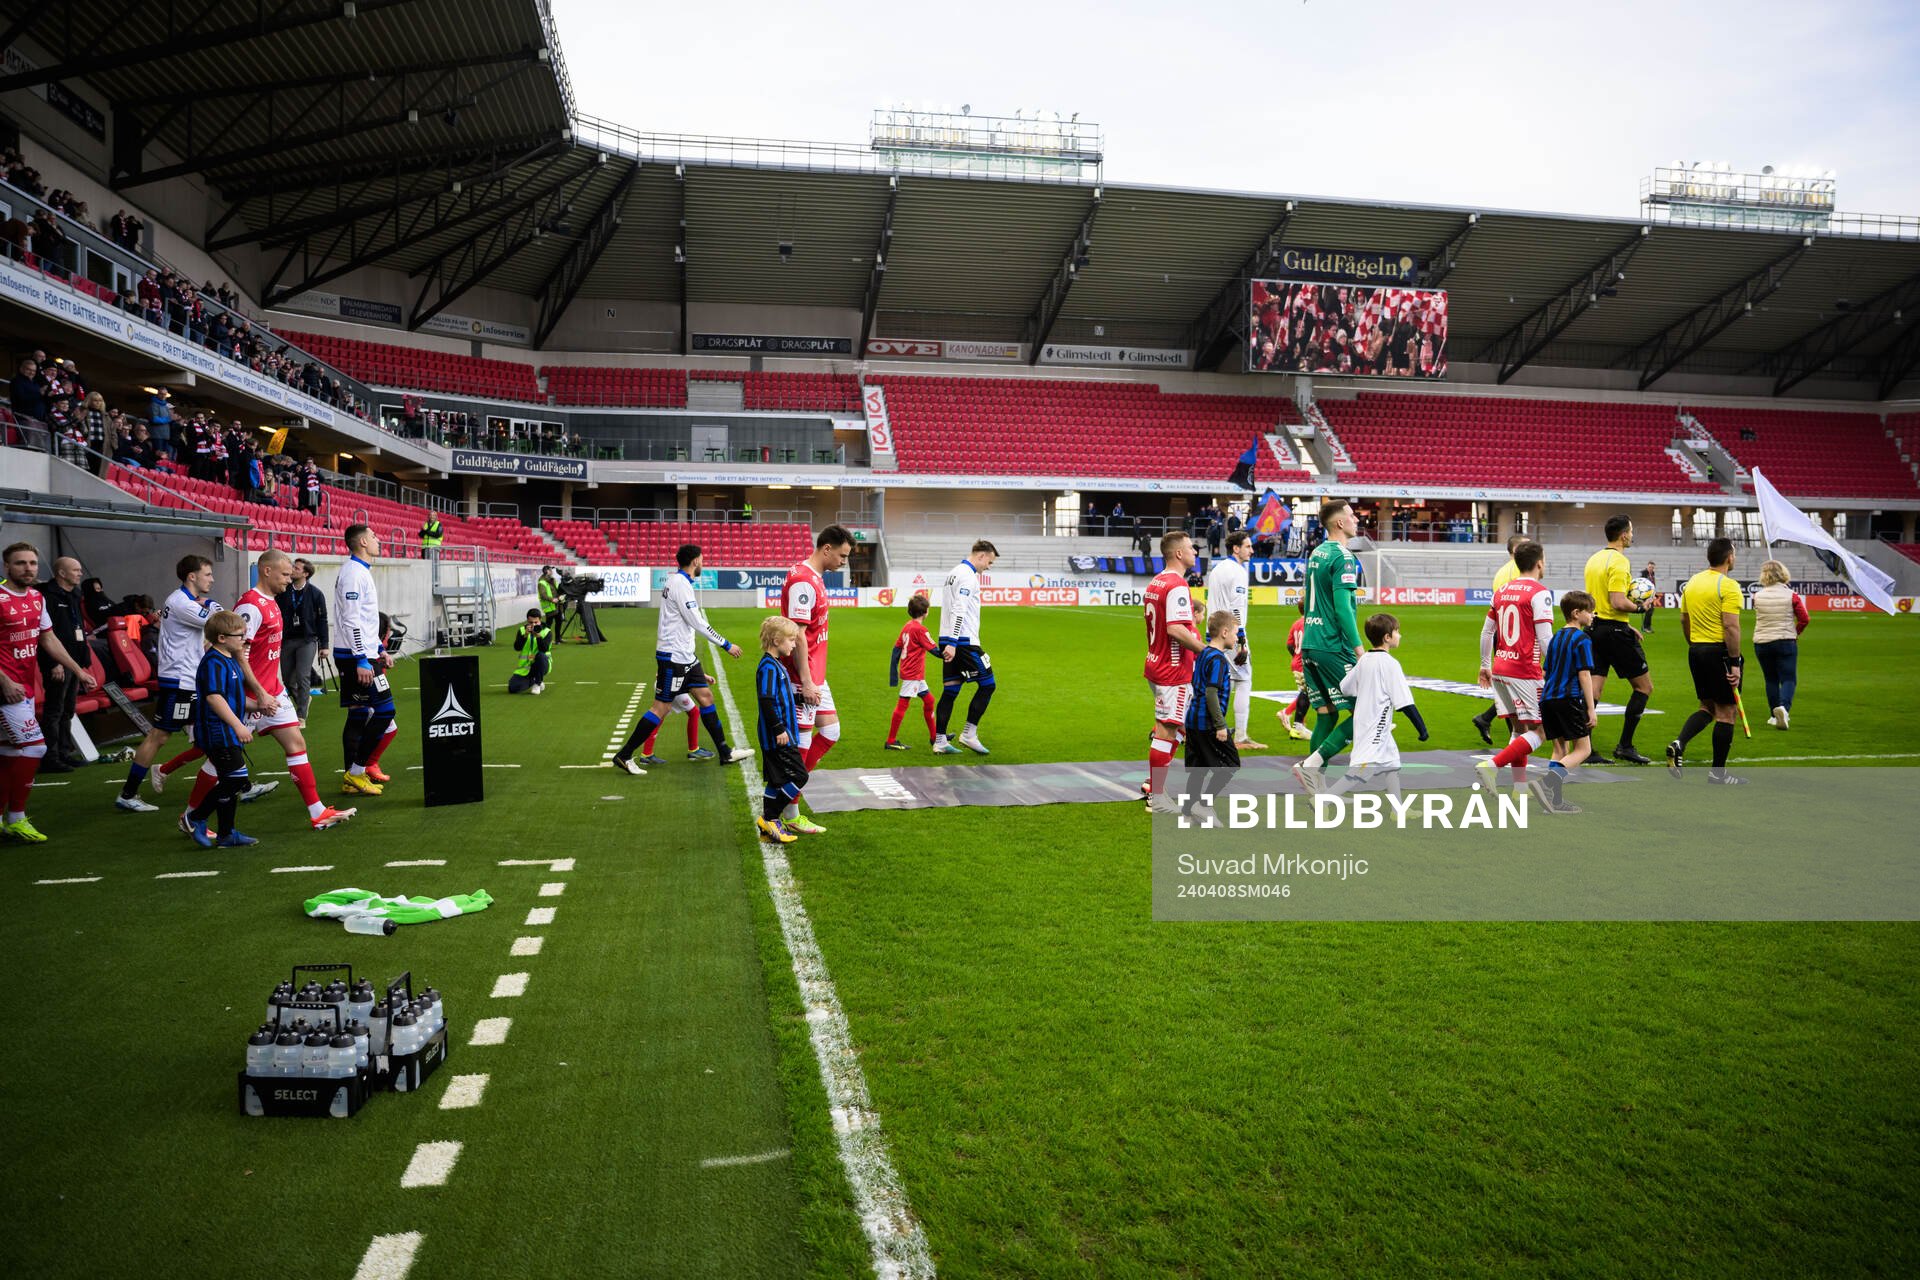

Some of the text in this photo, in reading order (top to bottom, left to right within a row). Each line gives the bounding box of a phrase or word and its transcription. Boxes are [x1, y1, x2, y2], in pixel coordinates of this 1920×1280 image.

[1283, 250, 1398, 279] GuldFågeln
[44, 291, 59, 307] FÖR
[60, 297, 71, 312] ETT
[72, 302, 97, 323] BÄTTRE
[97, 314, 122, 334] INTRYCK
[483, 326, 526, 339] infoservice
[708, 337, 835, 351] DRAGSPLÅT DRAGSPLÅT
[867, 341, 938, 355] OVE
[948, 343, 1006, 355] KANONADEN
[1057, 348, 1182, 364] Glimstedt Glimstedt
[866, 391, 882, 419] ICA
[872, 422, 889, 451] ICA
[456, 455, 578, 475] GuldFågeln GuldFågeln
[1047, 576, 1117, 589] infoservice
[1791, 582, 1847, 596] uldFågeln
[1030, 589, 1077, 602] renta
[1827, 597, 1865, 609] renta
[1497, 604, 1520, 647] 10
[428, 722, 476, 738] SELECT
[275, 1089, 318, 1101] SELECT
